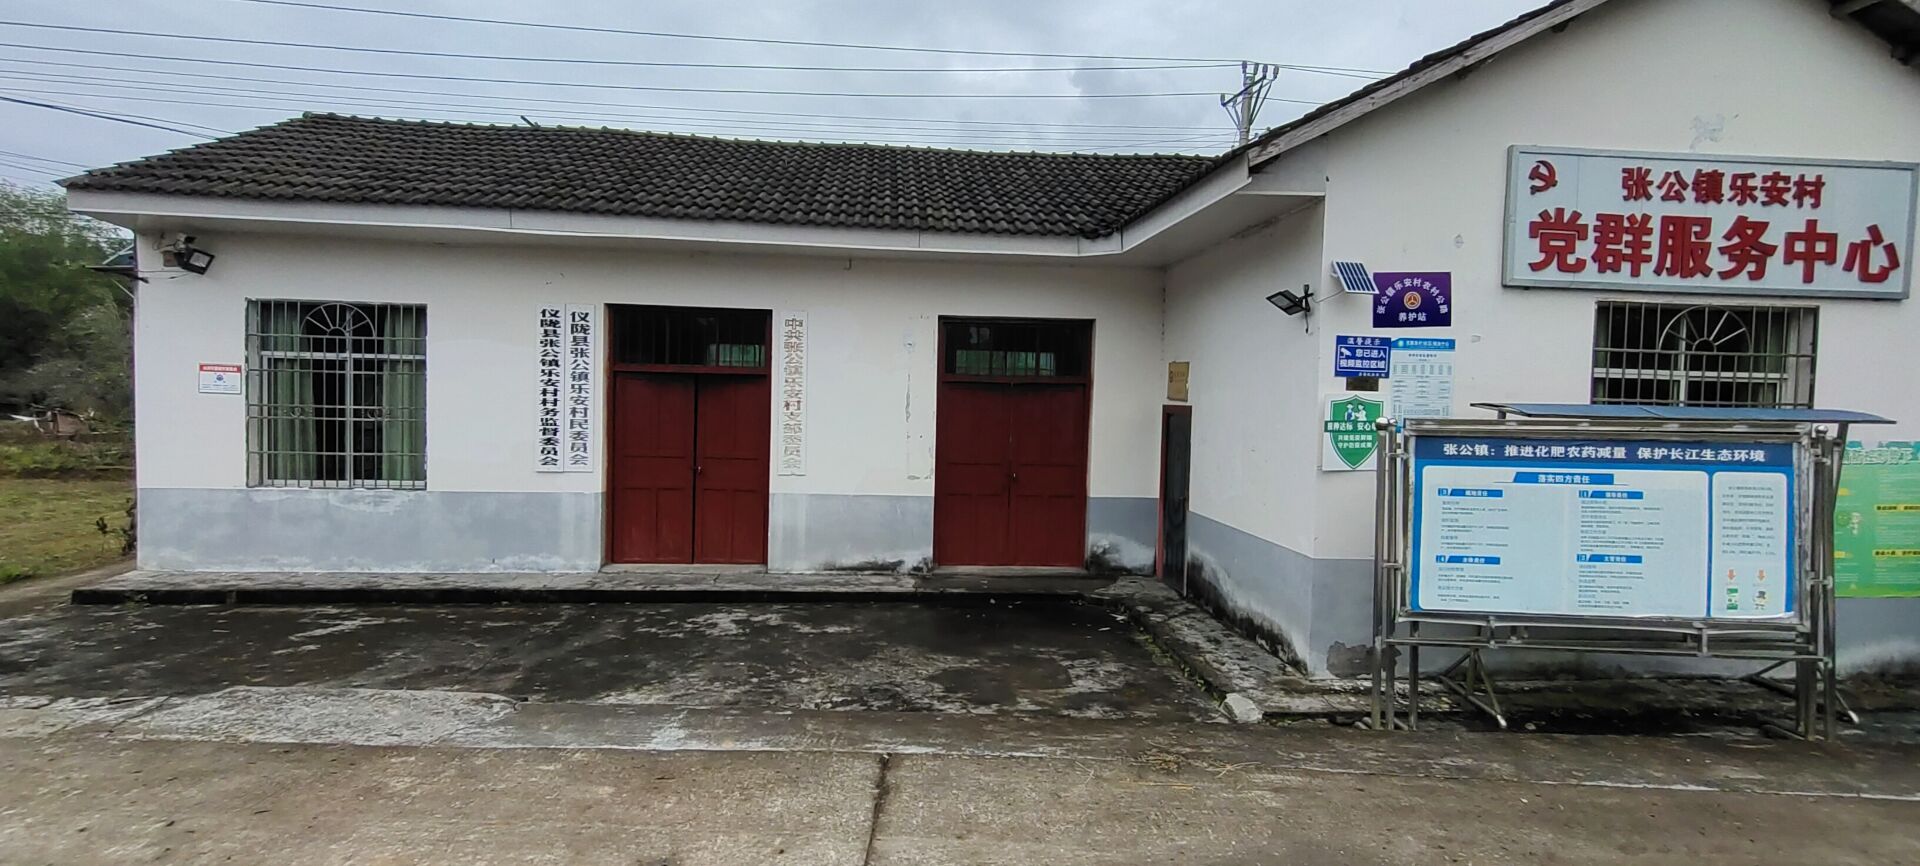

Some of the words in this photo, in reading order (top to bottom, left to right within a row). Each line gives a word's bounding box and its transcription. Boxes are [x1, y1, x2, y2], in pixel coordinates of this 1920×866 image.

[1622, 166, 1825, 209] 张公镇乐安村
[1528, 208, 1900, 283] 党群服务中心
[1376, 278, 1448, 314] 张公镇乐安村农村公路
[1398, 312, 1427, 322] 养护站
[1339, 359, 1386, 369] 视频监控区域
[1355, 349, 1386, 358] 您已进入
[538, 308, 561, 466] 仪陇县张公镇乐安村村务监督委员会
[569, 311, 591, 466] 仪陇县张公镇乐安村民委员会
[783, 318, 804, 469] 中共张公镇乐安村支部委员会
[1636, 446, 1766, 463] 保护长江生态环境
[1537, 474, 1591, 484] 落实四方责任
